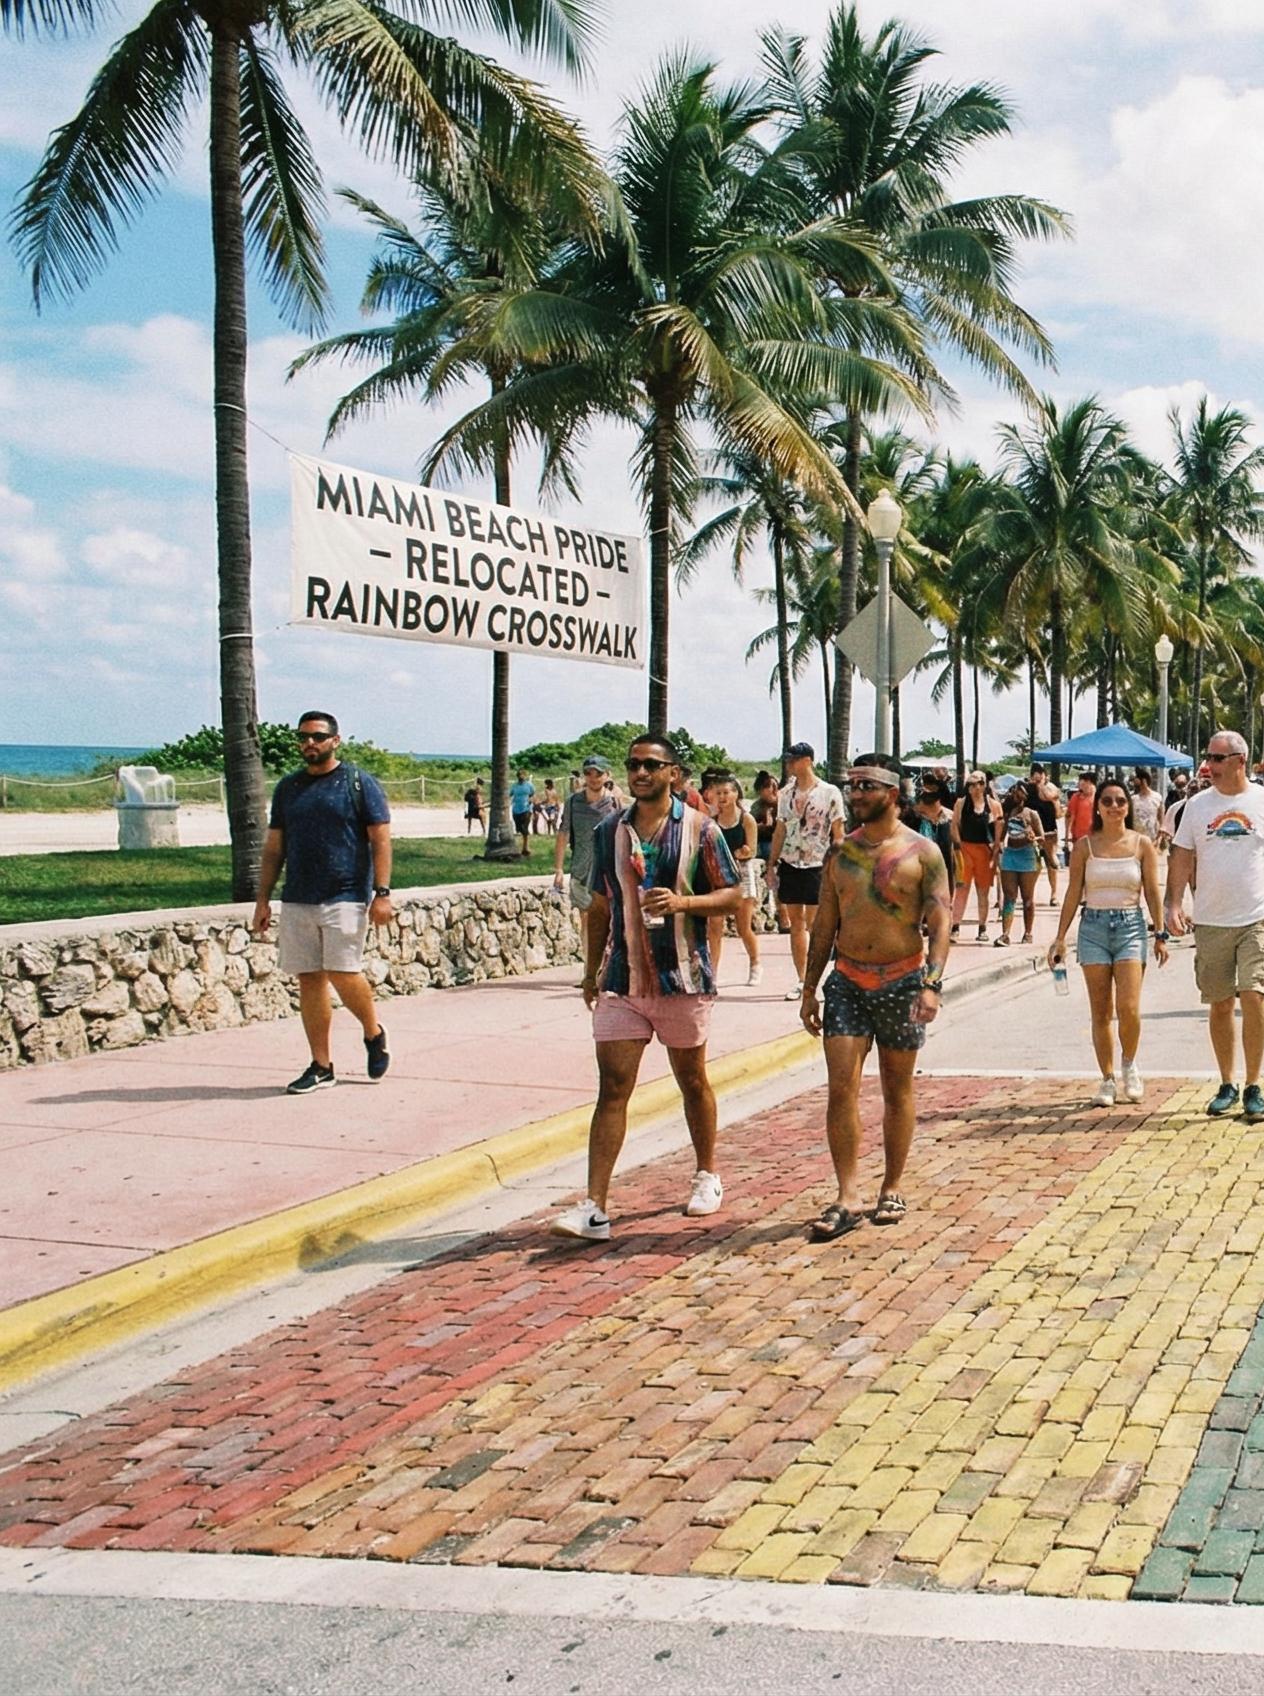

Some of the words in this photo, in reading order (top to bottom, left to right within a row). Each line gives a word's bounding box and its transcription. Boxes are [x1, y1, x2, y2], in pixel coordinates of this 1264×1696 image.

[317, 467, 435, 532] MIAMI
[444, 499, 548, 556] BEACH
[558, 526, 630, 574] PRIDE
[406, 538, 589, 607] RELOCATED
[306, 576, 480, 639] RAINBOW
[487, 604, 638, 660] CROSSWALK
